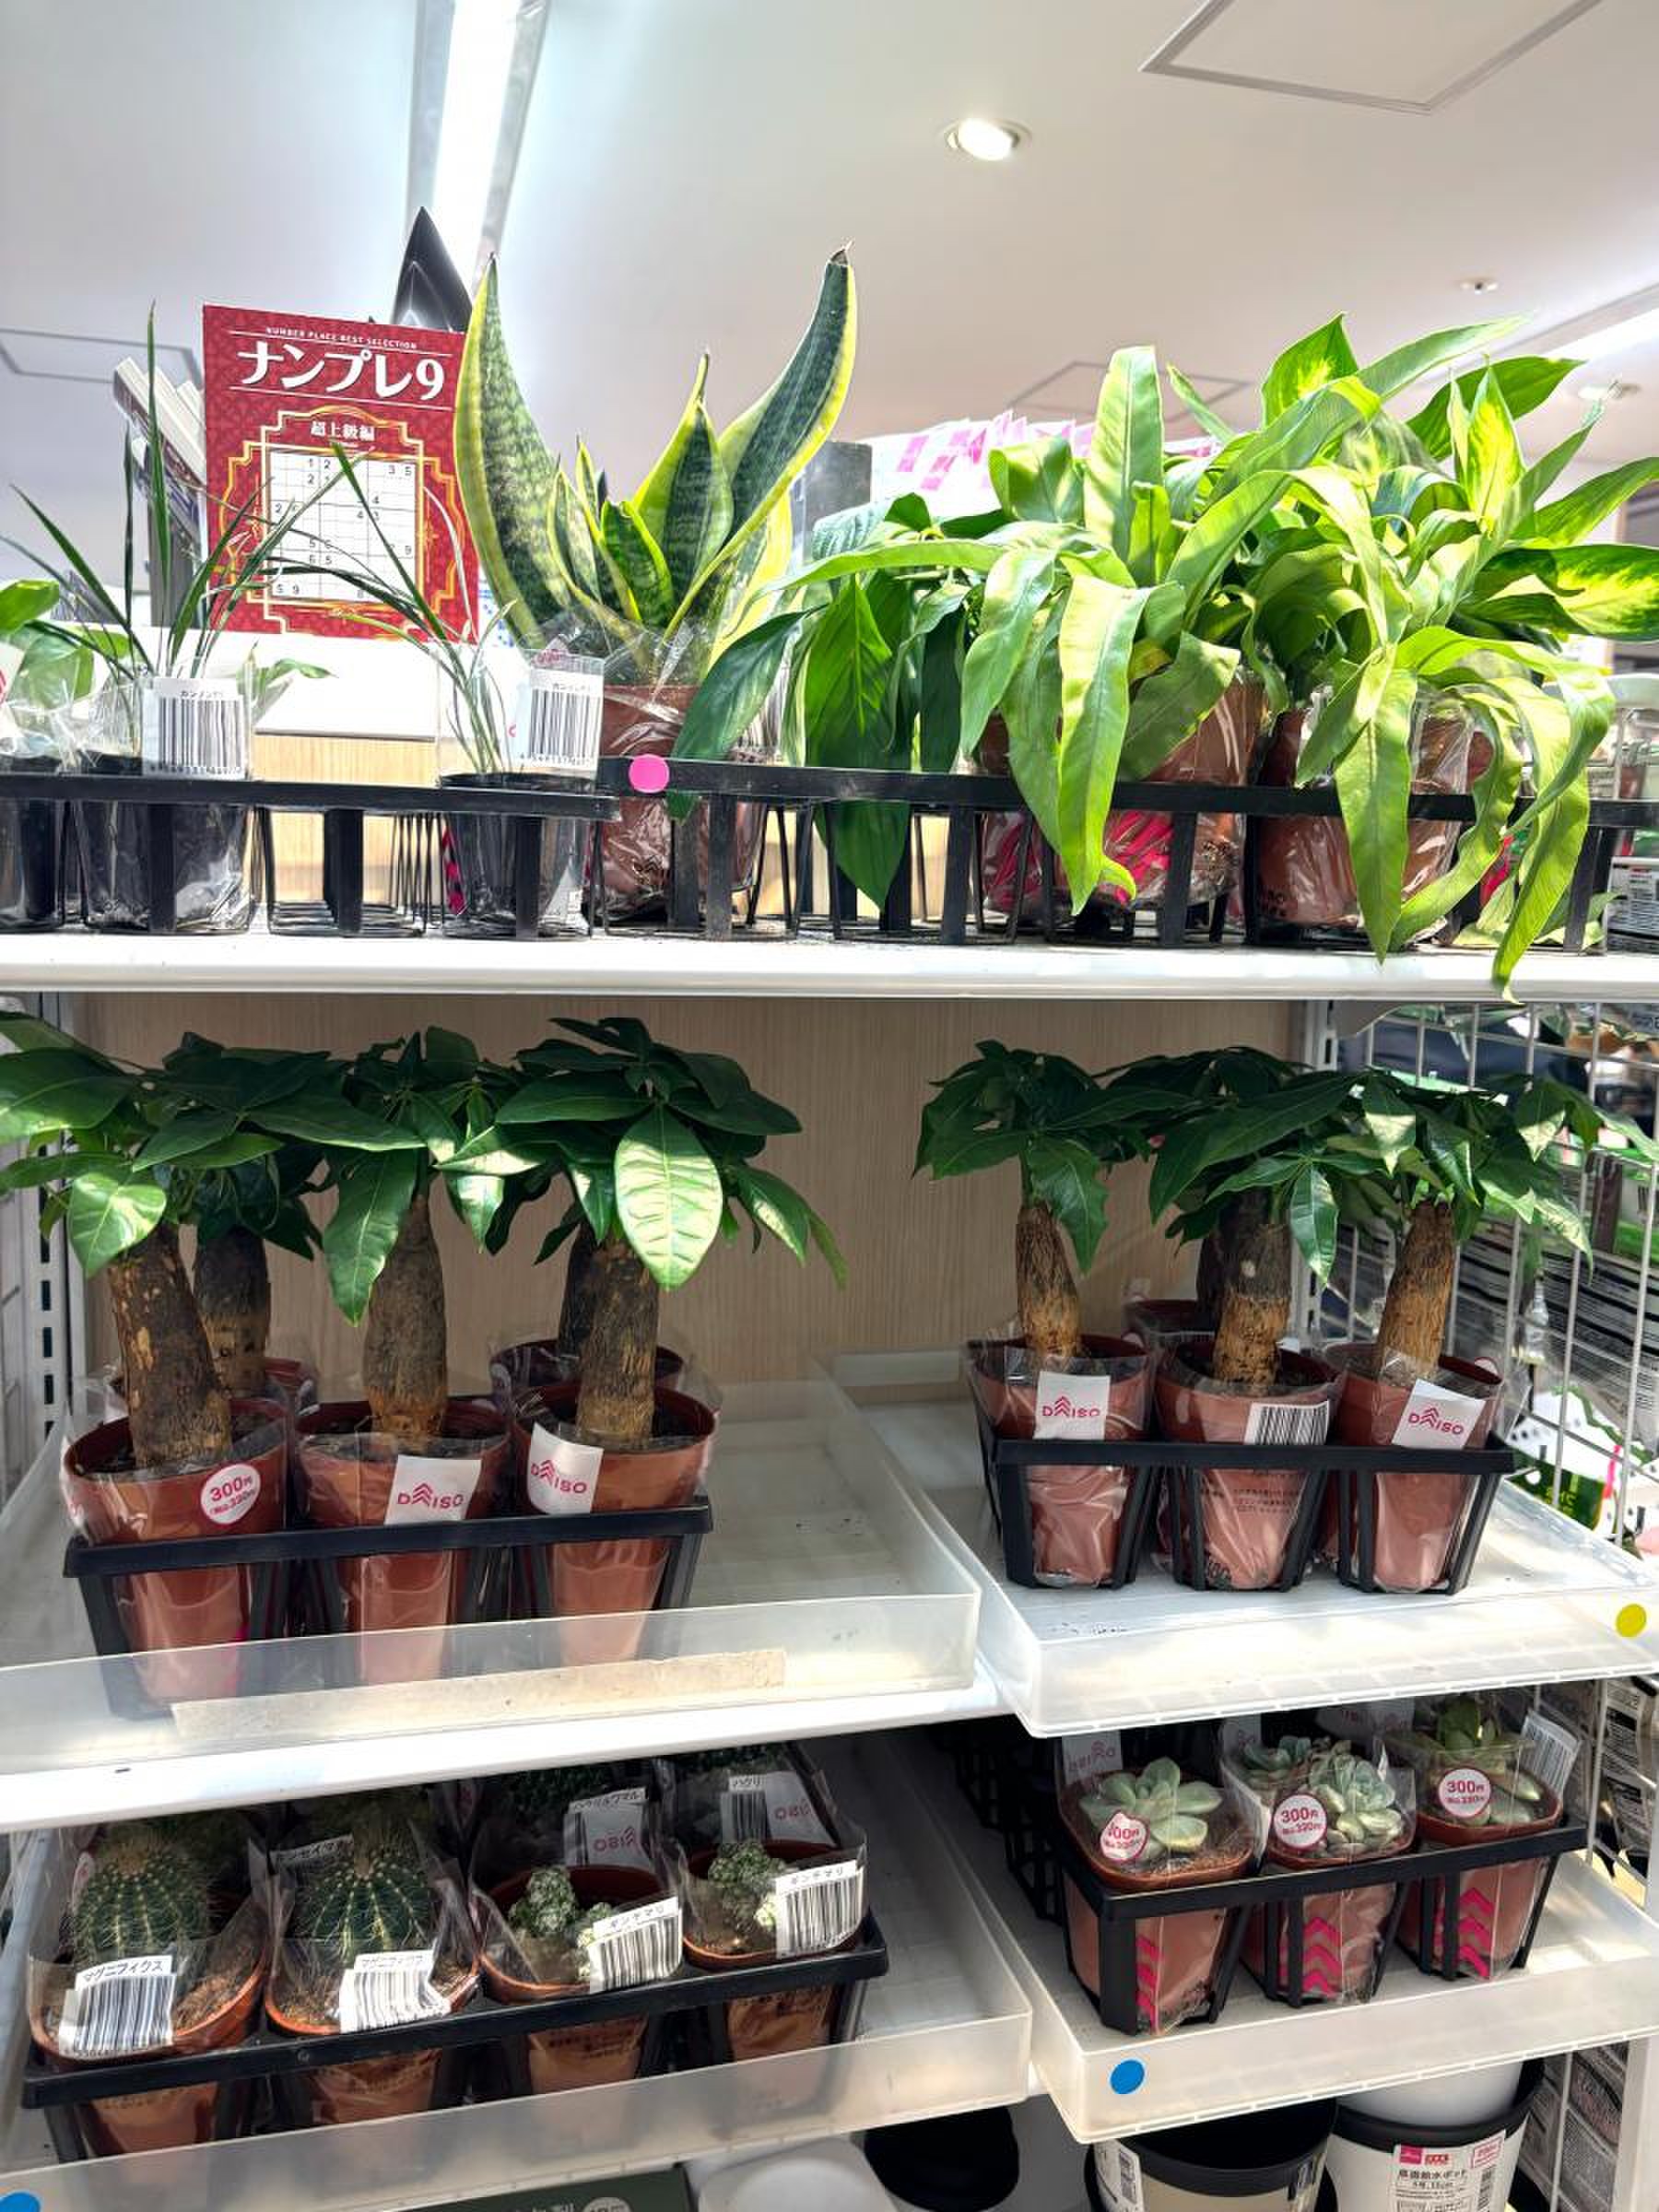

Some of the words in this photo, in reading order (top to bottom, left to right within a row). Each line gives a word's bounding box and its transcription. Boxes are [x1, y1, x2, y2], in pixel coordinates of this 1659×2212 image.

[367, 337, 418, 350] SELECTION
[237, 340, 445, 401] ナンプレ9
[311, 420, 376, 441] 超上級編
